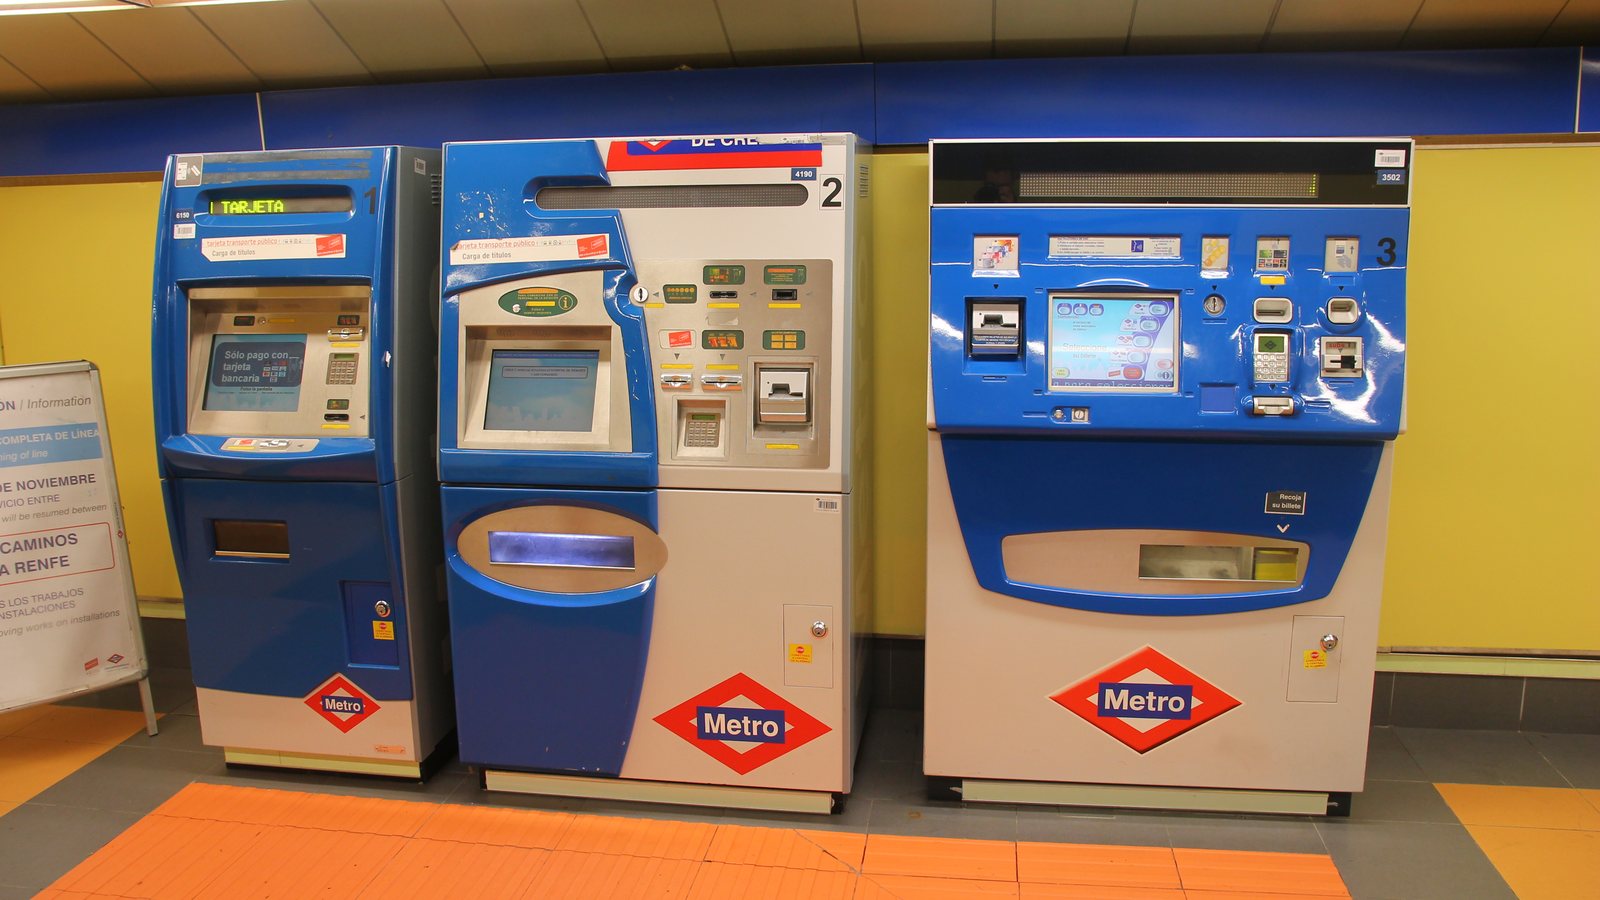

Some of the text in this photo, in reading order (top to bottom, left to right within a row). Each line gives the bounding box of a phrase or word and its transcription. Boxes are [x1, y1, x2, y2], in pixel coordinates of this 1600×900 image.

[692, 138, 763, 147] DE CRE
[795, 170, 812, 178] 4190
[1382, 173, 1401, 181] 3502
[822, 178, 842, 207] 2
[221, 200, 284, 214] TARJETA
[362, 187, 375, 215] 1
[207, 240, 226, 248] tarjeta
[227, 240, 257, 248] transporte
[479, 242, 512, 250] transporte
[462, 253, 480, 261] Carga
[1376, 237, 1397, 266] 3
[225, 350, 245, 359] Sólo
[247, 352, 270, 361] pago
[223, 362, 251, 373] tarjeta
[222, 374, 260, 383] bancaria
[27, 395, 90, 408] Information
[0, 428, 98, 444] OMPLETA DE LÍNEA
[20, 450, 29, 459] of
[32, 449, 47, 457] line
[16, 473, 96, 490] NOVIEMBRE
[28, 494, 60, 505] ENTRE
[1279, 493, 1302, 502] Recoja
[19, 511, 30, 520] be
[33, 507, 70, 518] resumed
[72, 504, 107, 514] between
[0, 533, 78, 554] CAMINOS
[15, 555, 70, 574] RENFE
[9, 596, 29, 606] LOS
[32, 587, 84, 603] TRABAJOS
[26, 621, 54, 631] works
[71, 609, 120, 623] installations
[325, 698, 361, 712] Metro
[1104, 688, 1185, 712] Metro
[704, 712, 778, 737] Metro
